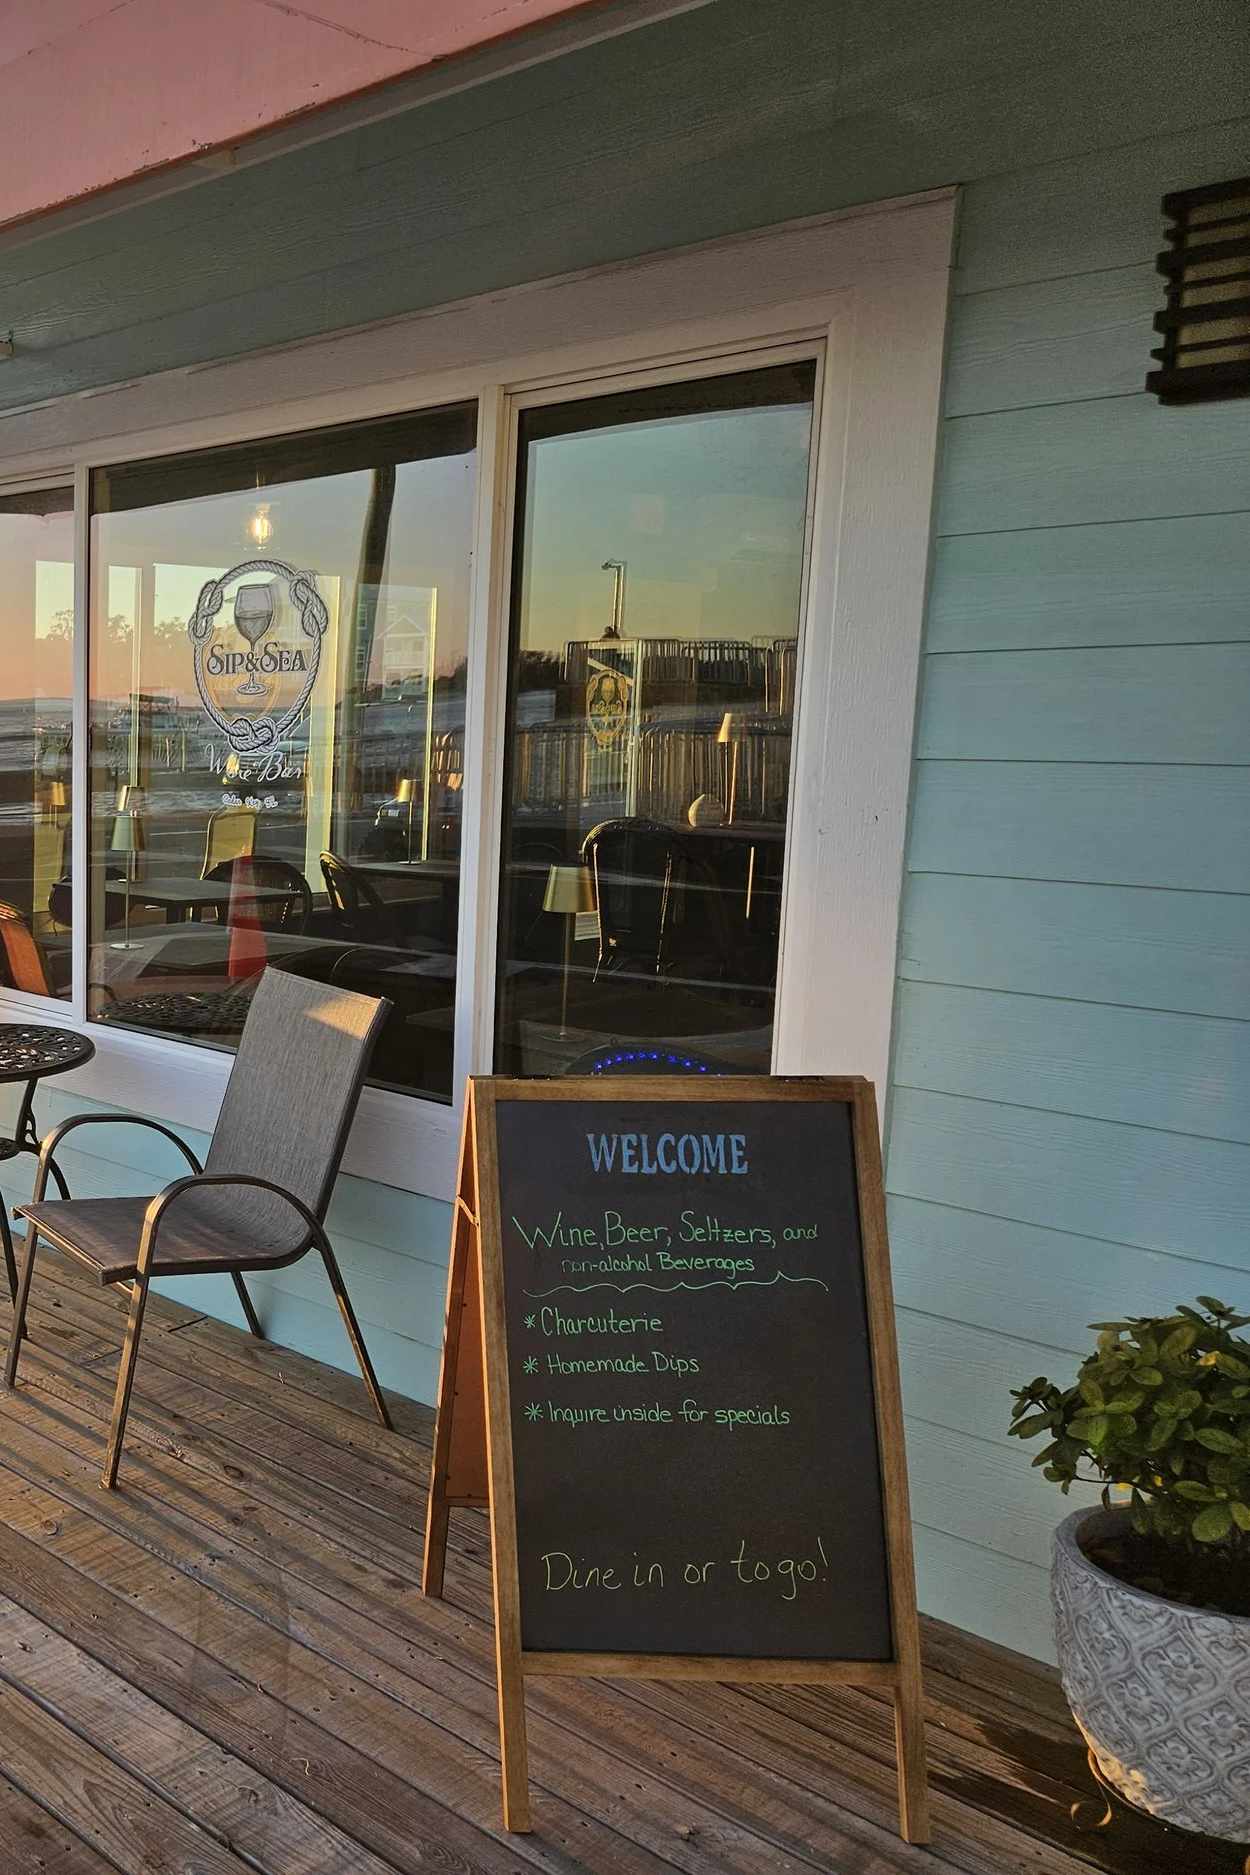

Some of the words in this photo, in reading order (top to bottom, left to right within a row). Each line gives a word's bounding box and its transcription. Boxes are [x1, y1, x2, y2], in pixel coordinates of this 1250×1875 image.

[586, 1133, 748, 1175] WELCOME
[512, 1211, 604, 1250] Wine,
[605, 1210, 671, 1246] Beer,
[679, 1210, 776, 1249] Seltzers,
[783, 1224, 818, 1241] and
[561, 1253, 653, 1273] non-alcohol
[656, 1251, 755, 1279] Beverages
[541, 1306, 664, 1337] Charcuterie
[547, 1354, 650, 1375] Homemade
[651, 1351, 700, 1377] Dips
[548, 1400, 611, 1428] Inquire
[614, 1403, 674, 1423] inside
[678, 1400, 709, 1423] for
[715, 1405, 791, 1432] specials
[541, 1552, 622, 1590] Dine
[633, 1551, 664, 1588] in
[683, 1562, 716, 1584] or
